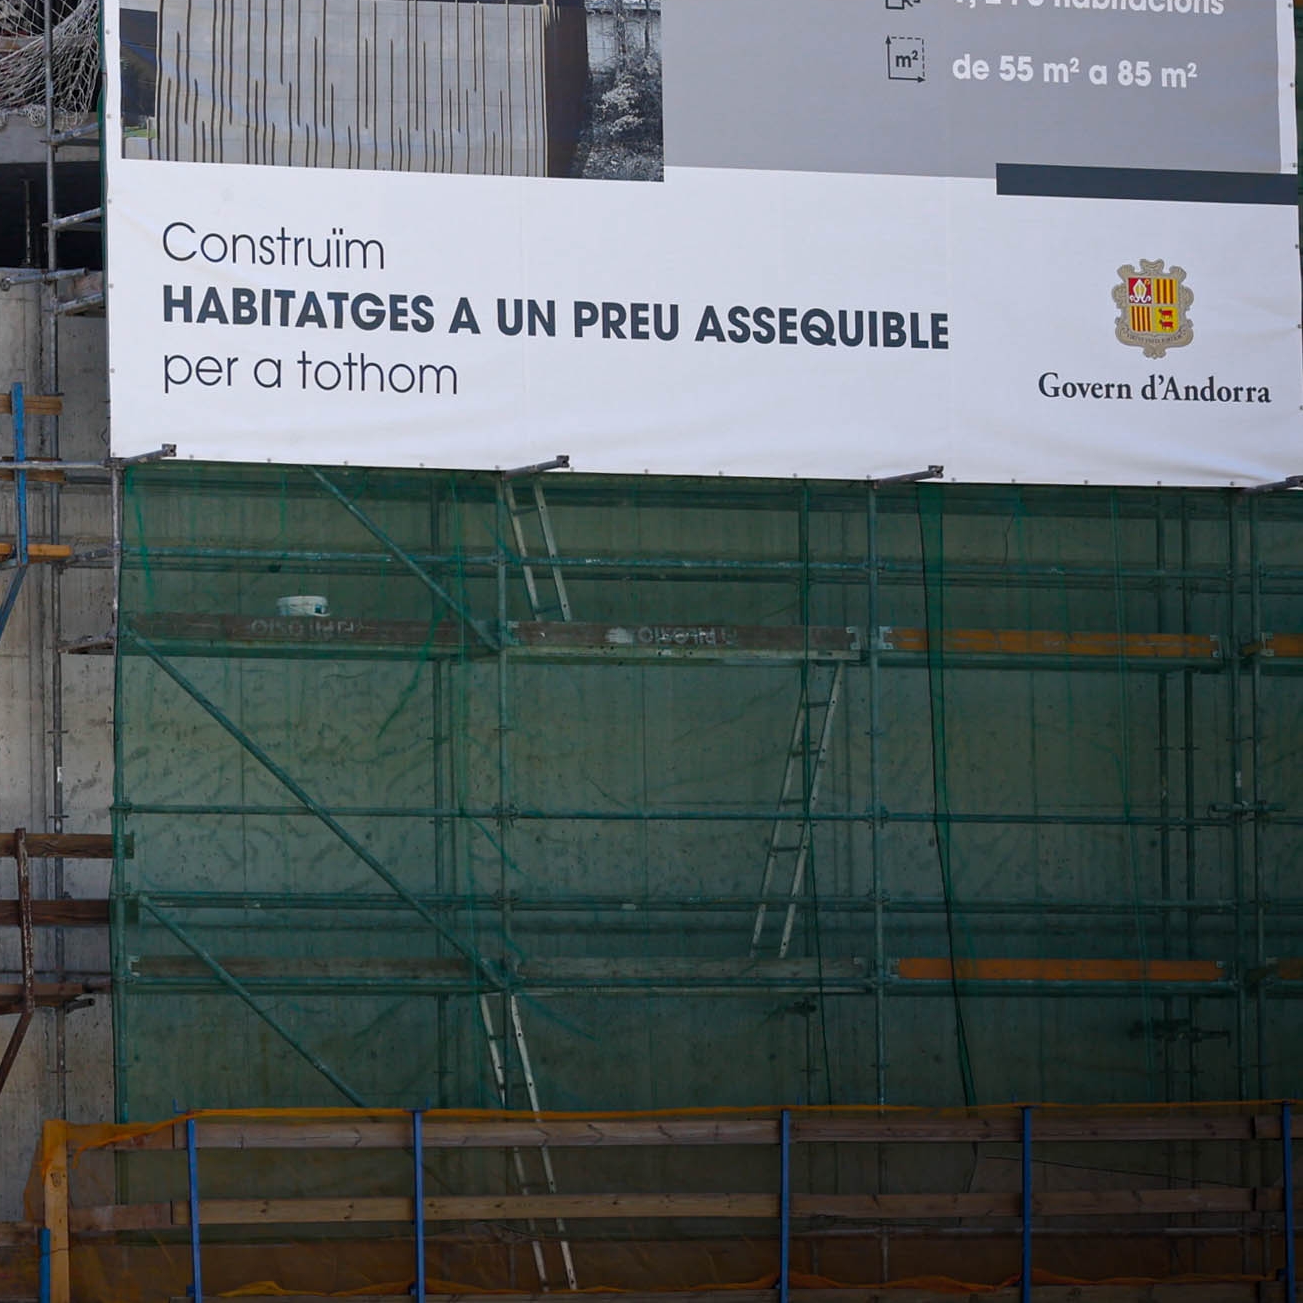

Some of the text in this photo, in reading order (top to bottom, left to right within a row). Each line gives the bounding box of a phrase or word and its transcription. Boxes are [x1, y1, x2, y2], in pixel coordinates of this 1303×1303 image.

[952, 54, 1198, 88] de 55 m² a 85 m²
[163, 222, 384, 269] Construïm
[163, 284, 949, 350] HABITATGES A UN PREU ASSEQUIBLE
[163, 350, 458, 395] per a tothom
[1038, 372, 1133, 399] Govern
